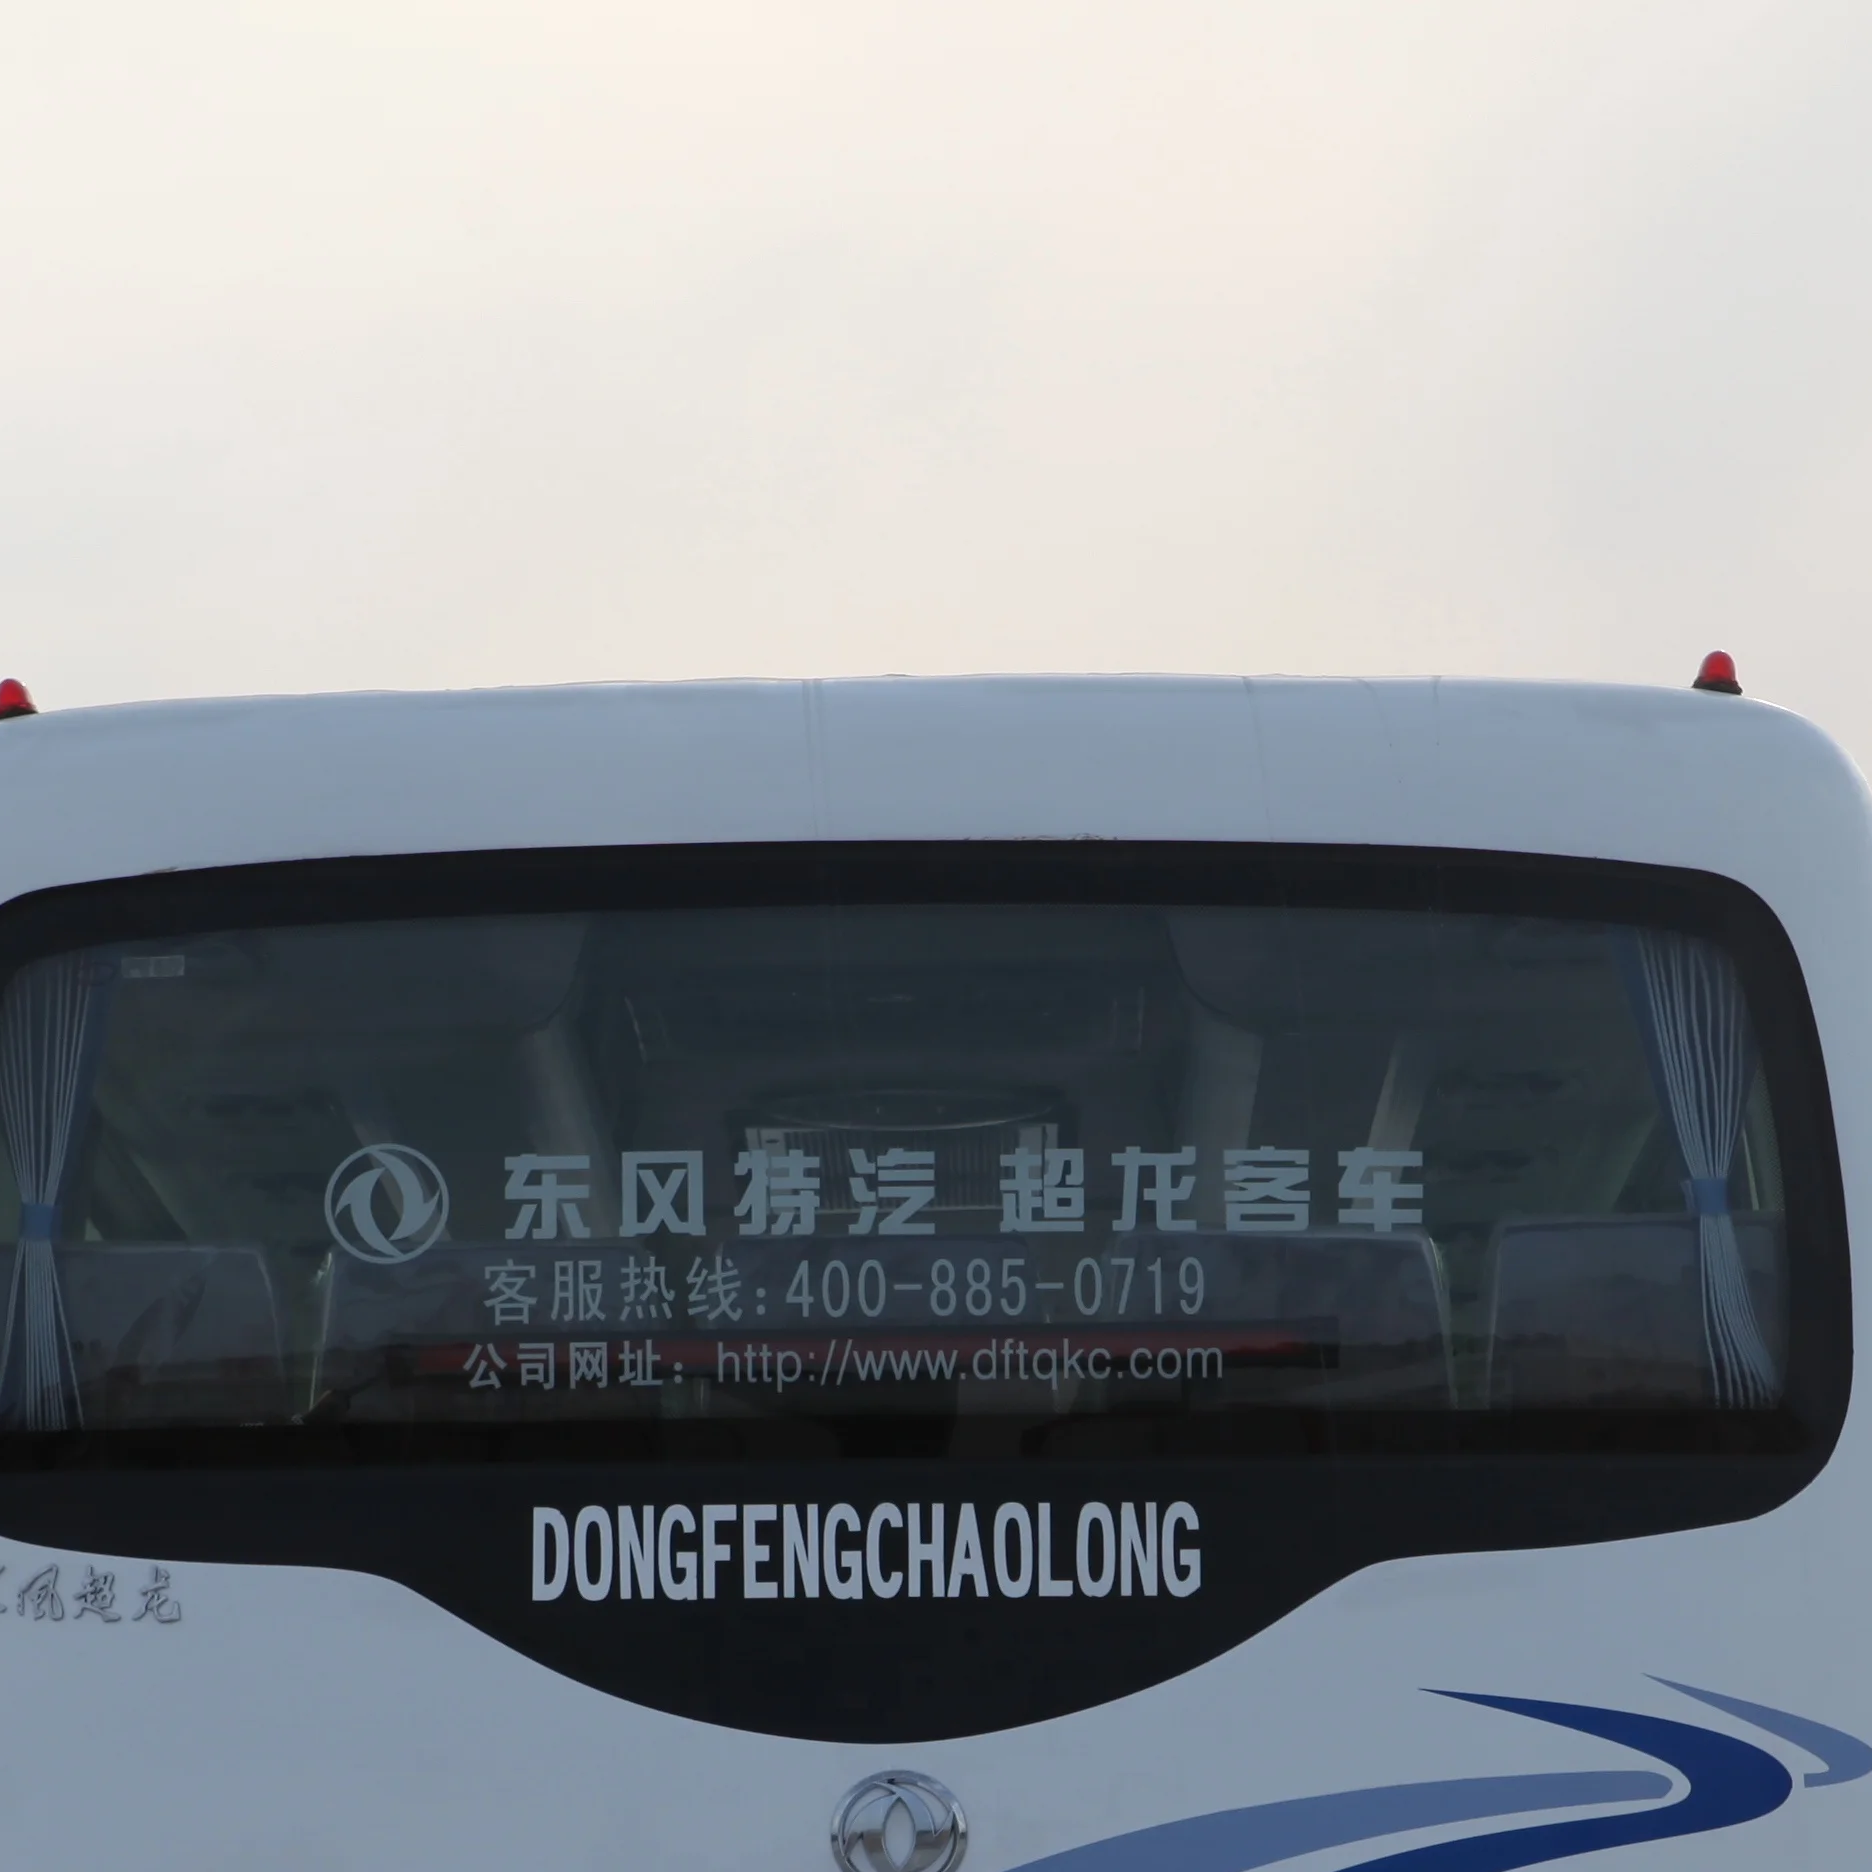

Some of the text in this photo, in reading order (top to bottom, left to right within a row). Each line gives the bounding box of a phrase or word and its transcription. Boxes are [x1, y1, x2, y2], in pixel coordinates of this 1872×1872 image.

[504, 1146, 1424, 1240] 东风特汽 超龙客车
[532, 1502, 1202, 1602] DONGFENGCHAOLONG
